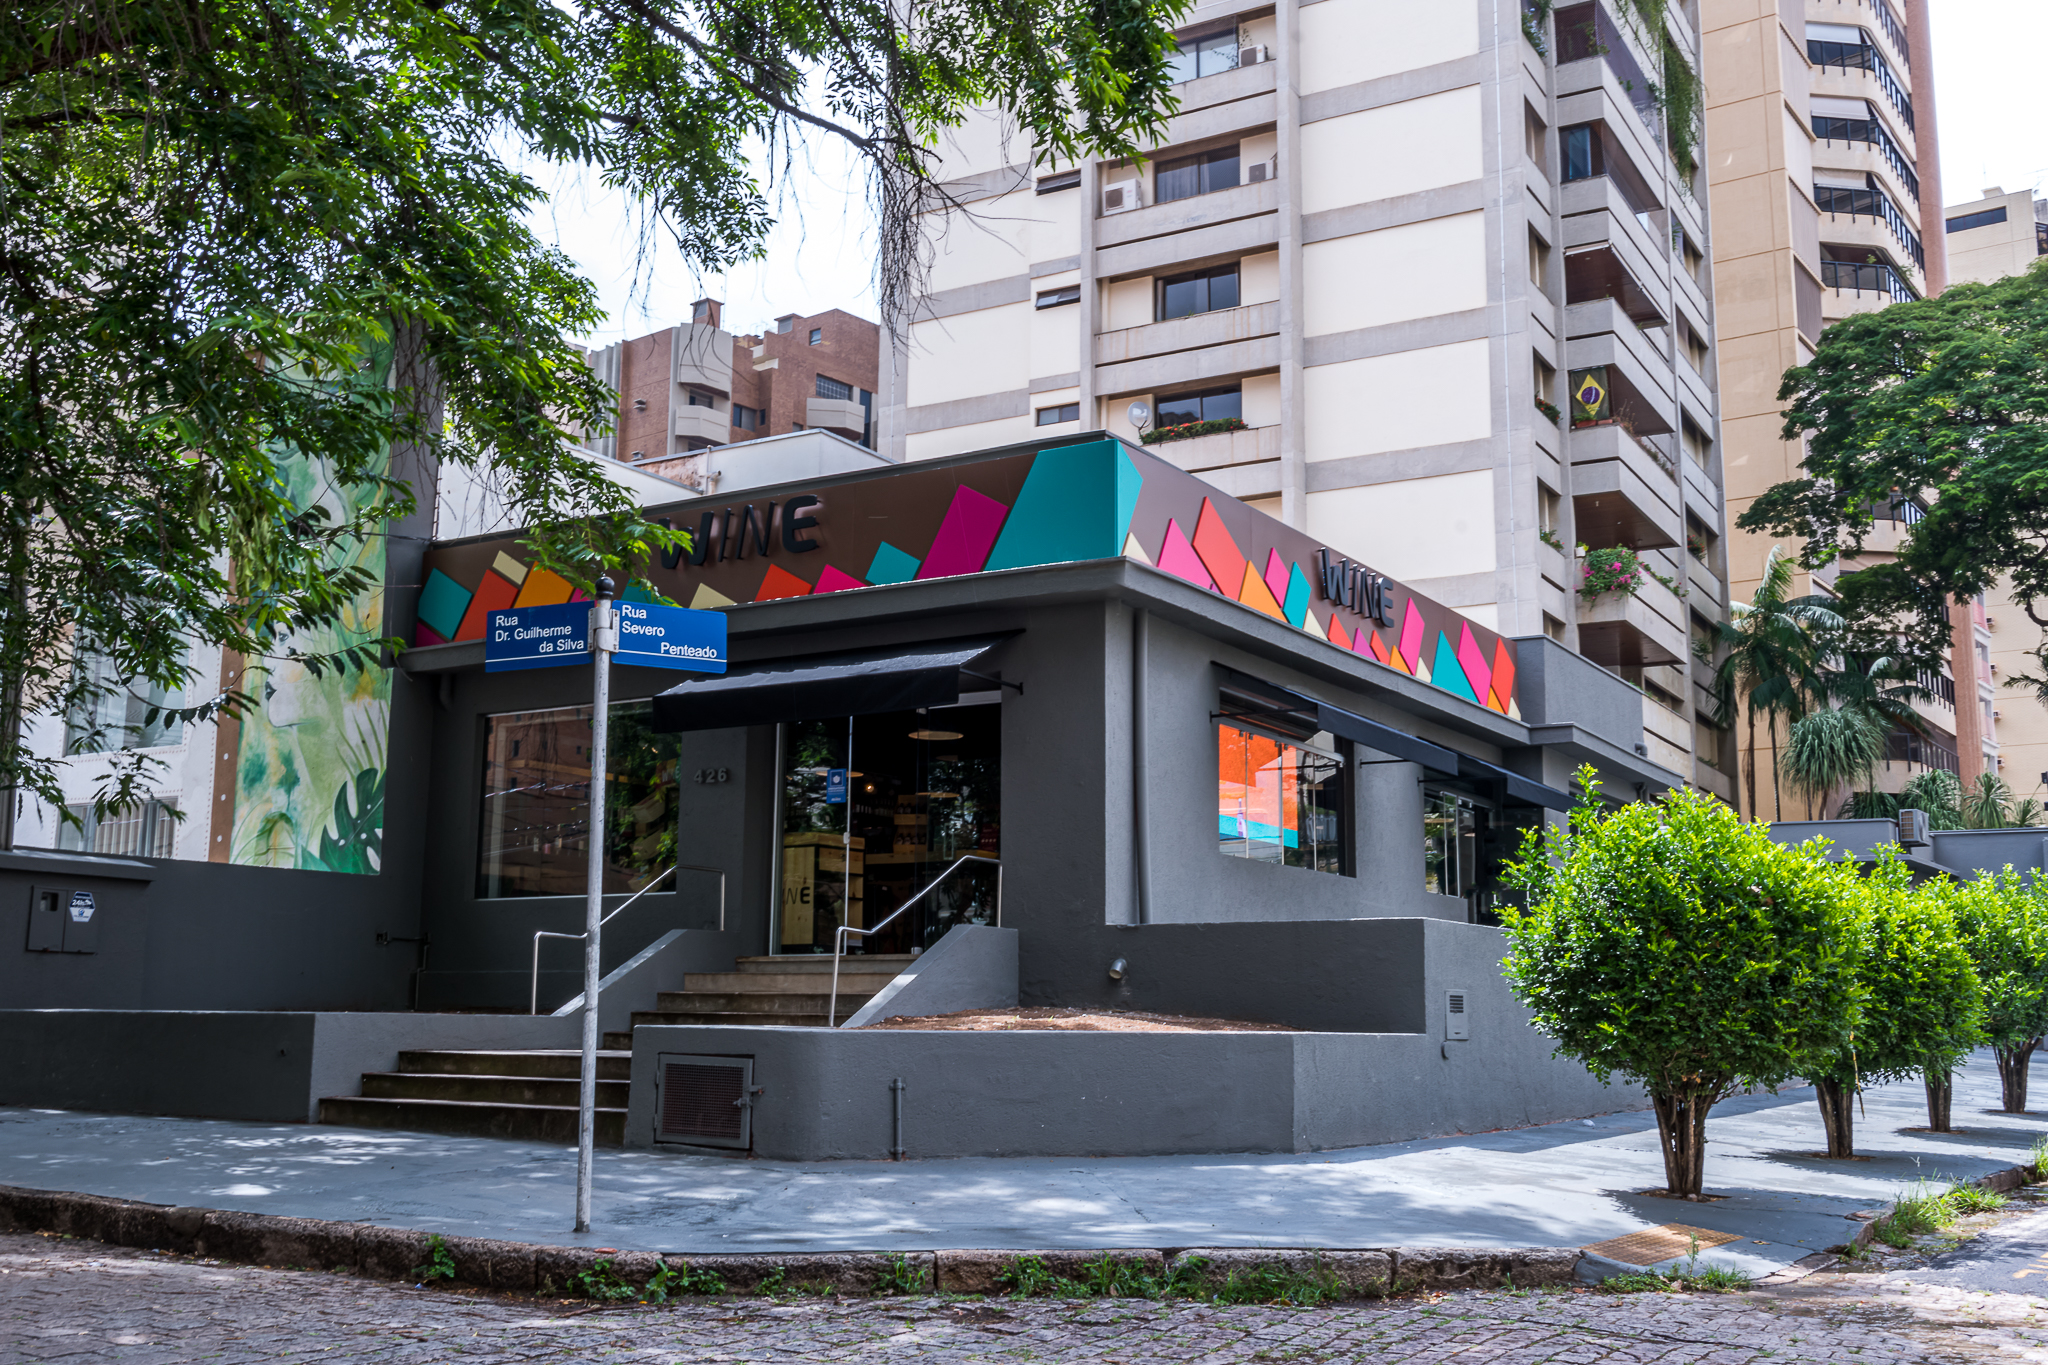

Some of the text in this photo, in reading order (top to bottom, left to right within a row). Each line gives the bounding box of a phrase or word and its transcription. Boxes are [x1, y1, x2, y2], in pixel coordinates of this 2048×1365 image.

[658, 494, 819, 569] WINE
[1320, 547, 1394, 628] WINE
[622, 604, 647, 619] Rua
[495, 615, 518, 627] Rua
[622, 621, 665, 637] Severo
[495, 630, 511, 642] Dr.
[514, 625, 572, 640] Guilherme
[539, 639, 584, 653] da Silva
[661, 641, 717, 658] Penteado
[693, 767, 727, 784] 426
